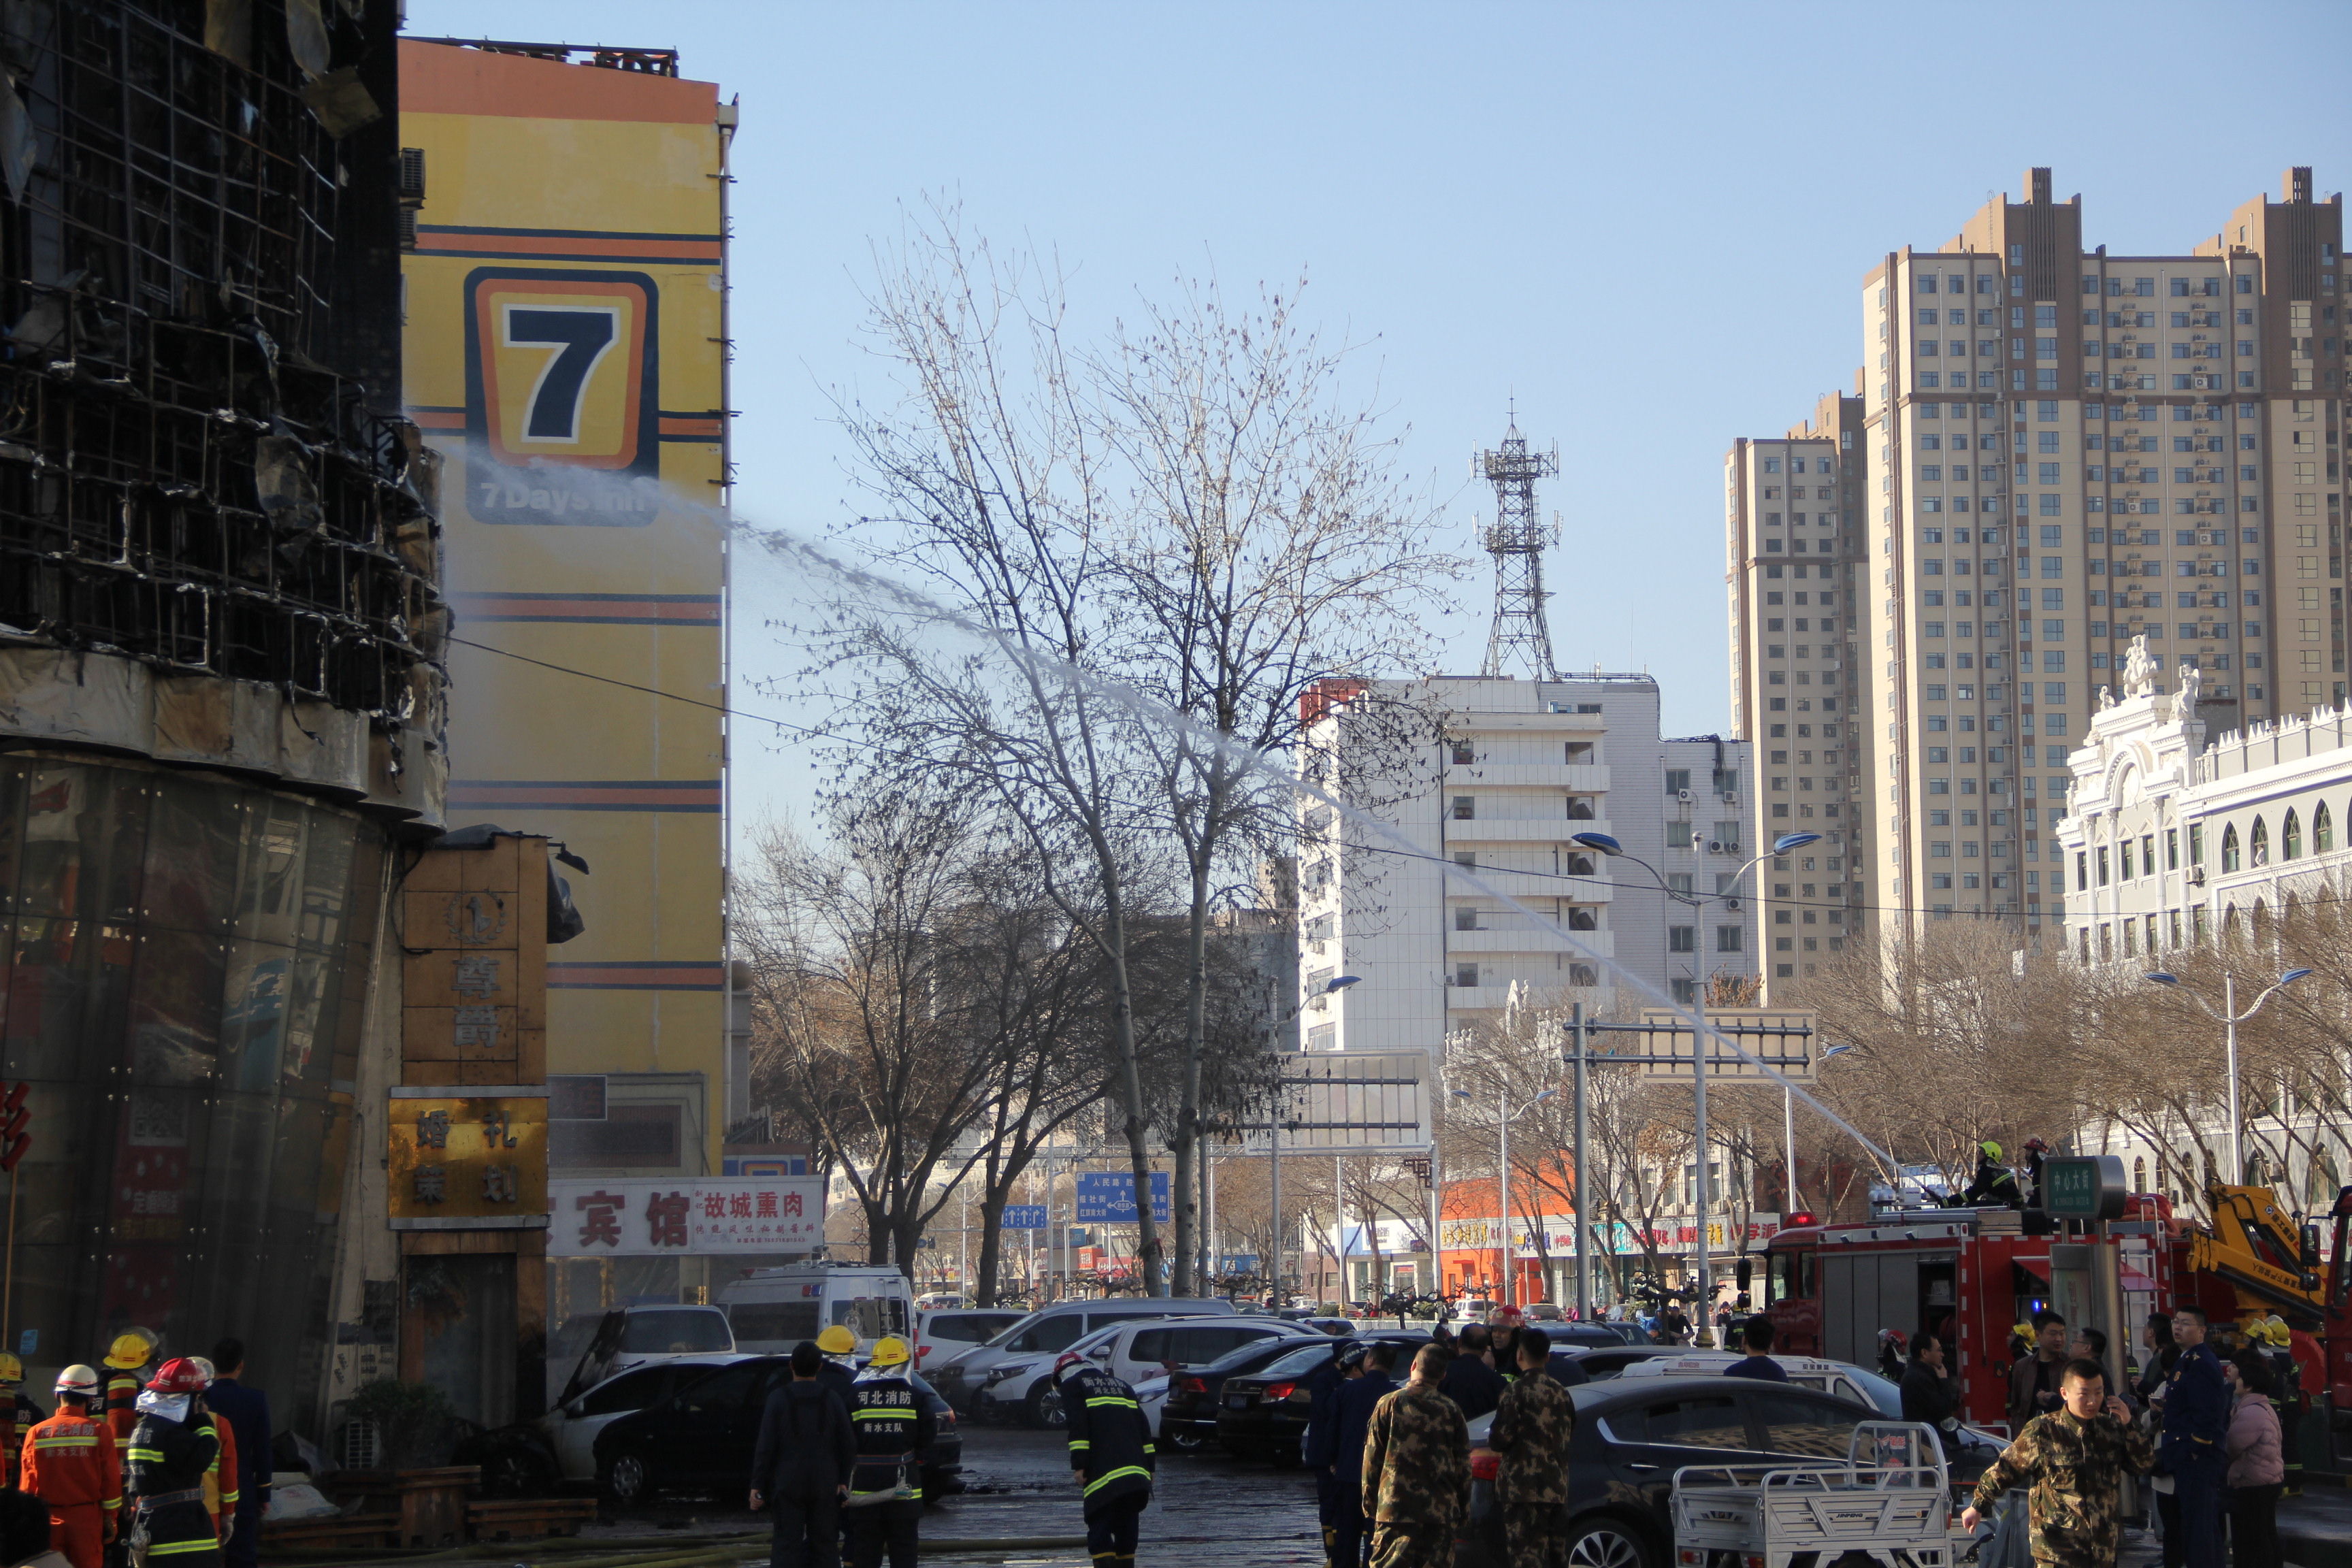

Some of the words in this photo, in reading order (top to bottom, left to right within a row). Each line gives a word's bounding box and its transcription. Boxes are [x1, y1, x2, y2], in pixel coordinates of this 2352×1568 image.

[502, 304, 620, 444] 7
[453, 956, 502, 1048] 尊爵
[416, 1110, 517, 1149] 婚礼
[414, 1165, 517, 1204] 策划
[1093, 1178, 1120, 1187] 人民路
[2055, 1169, 2089, 1192] 中心大街
[704, 1192, 803, 1218] 故城熏肉
[1079, 1195, 1107, 1203] 报社街
[546, 1190, 690, 1248] 宾馆
[1080, 1209, 1107, 1217] 红旗南大街
[858, 1390, 912, 1405] 河北消防
[41, 1424, 95, 1437] 河北消防
[864, 1422, 904, 1433] 衡水支队
[46, 1447, 90, 1458] 衡水支队
